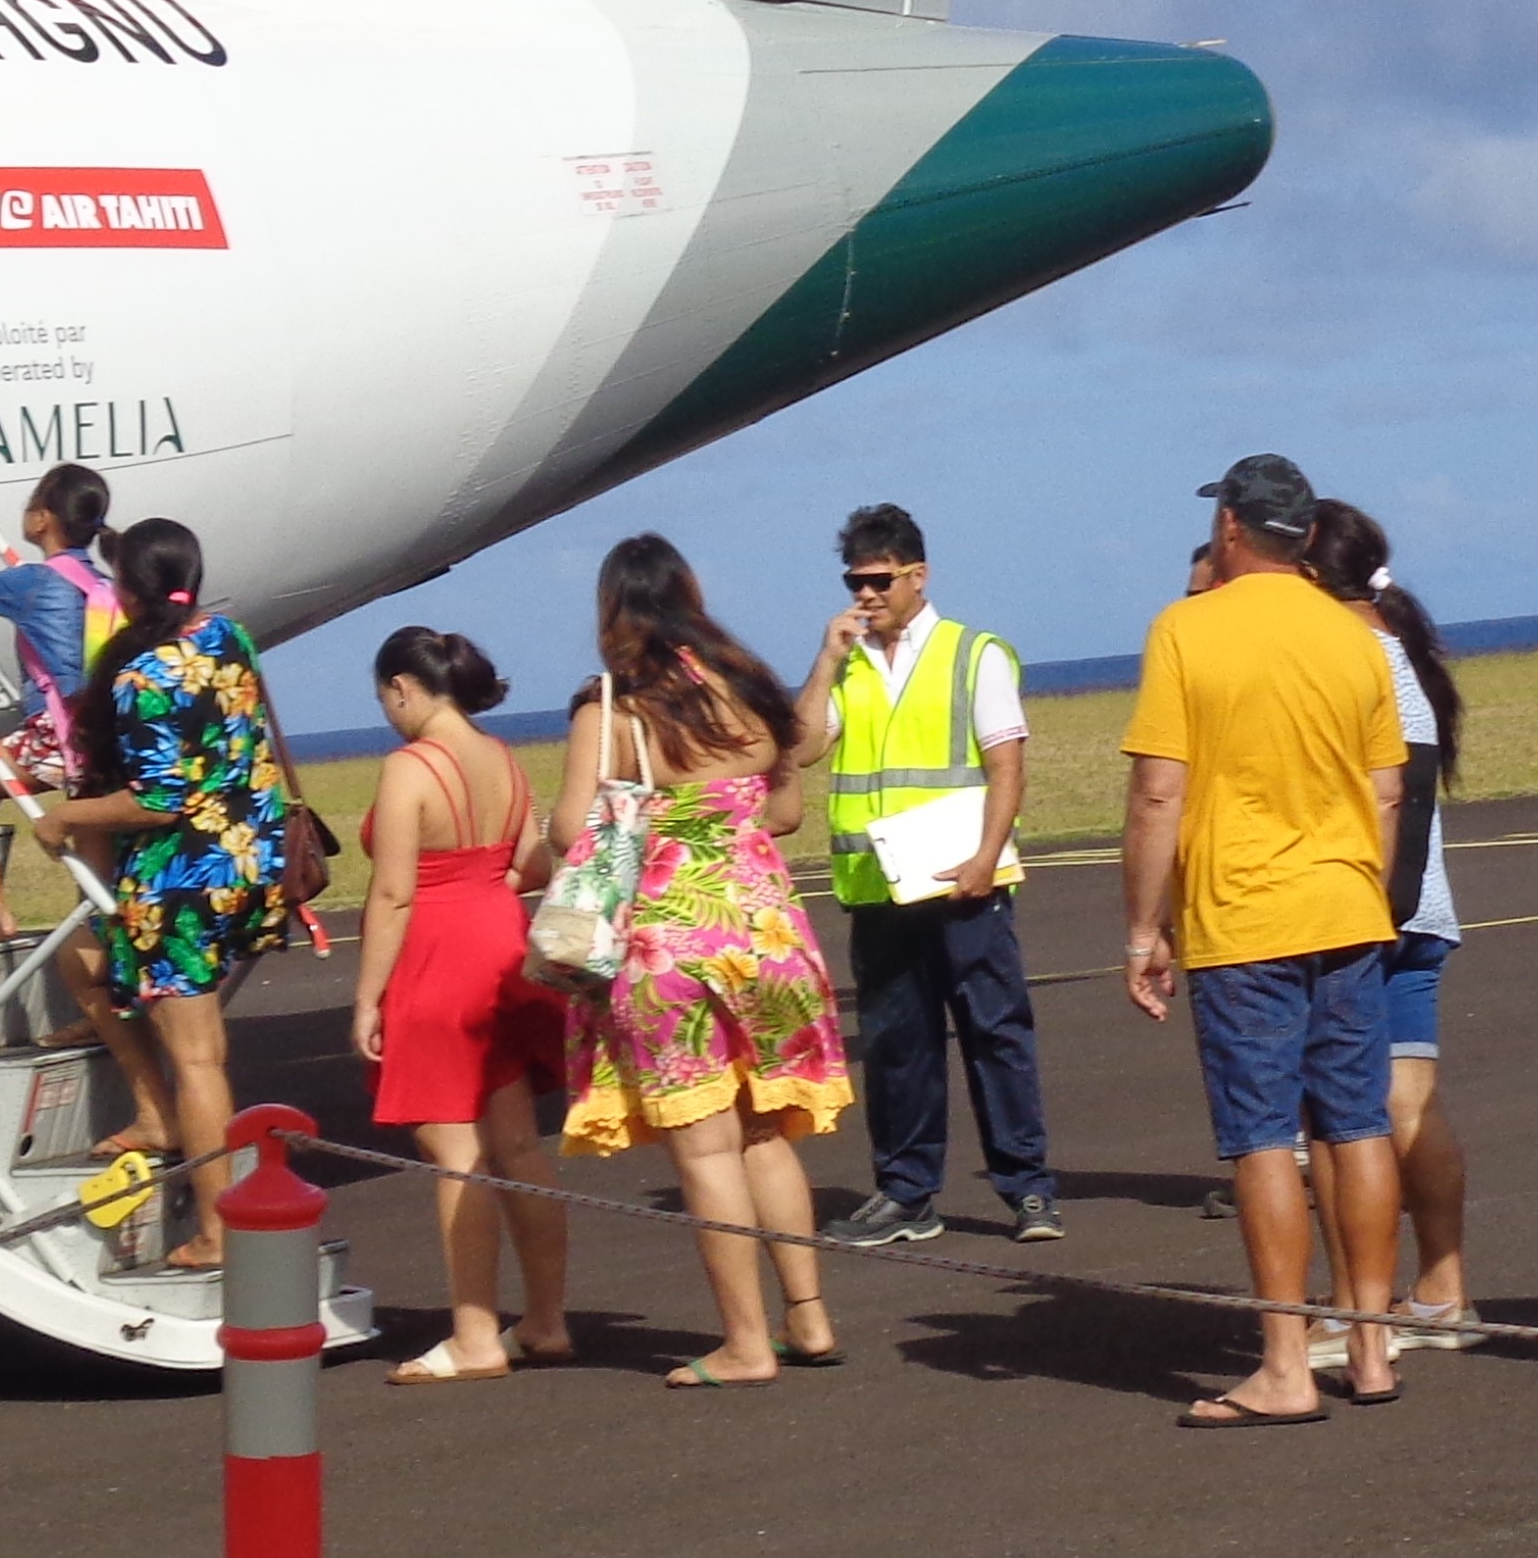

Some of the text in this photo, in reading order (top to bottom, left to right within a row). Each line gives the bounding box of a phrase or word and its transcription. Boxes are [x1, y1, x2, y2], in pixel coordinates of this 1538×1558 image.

[41, 193, 205, 231] AIR TAHITI
[55, 323, 86, 349] par
[71, 354, 94, 385] by
